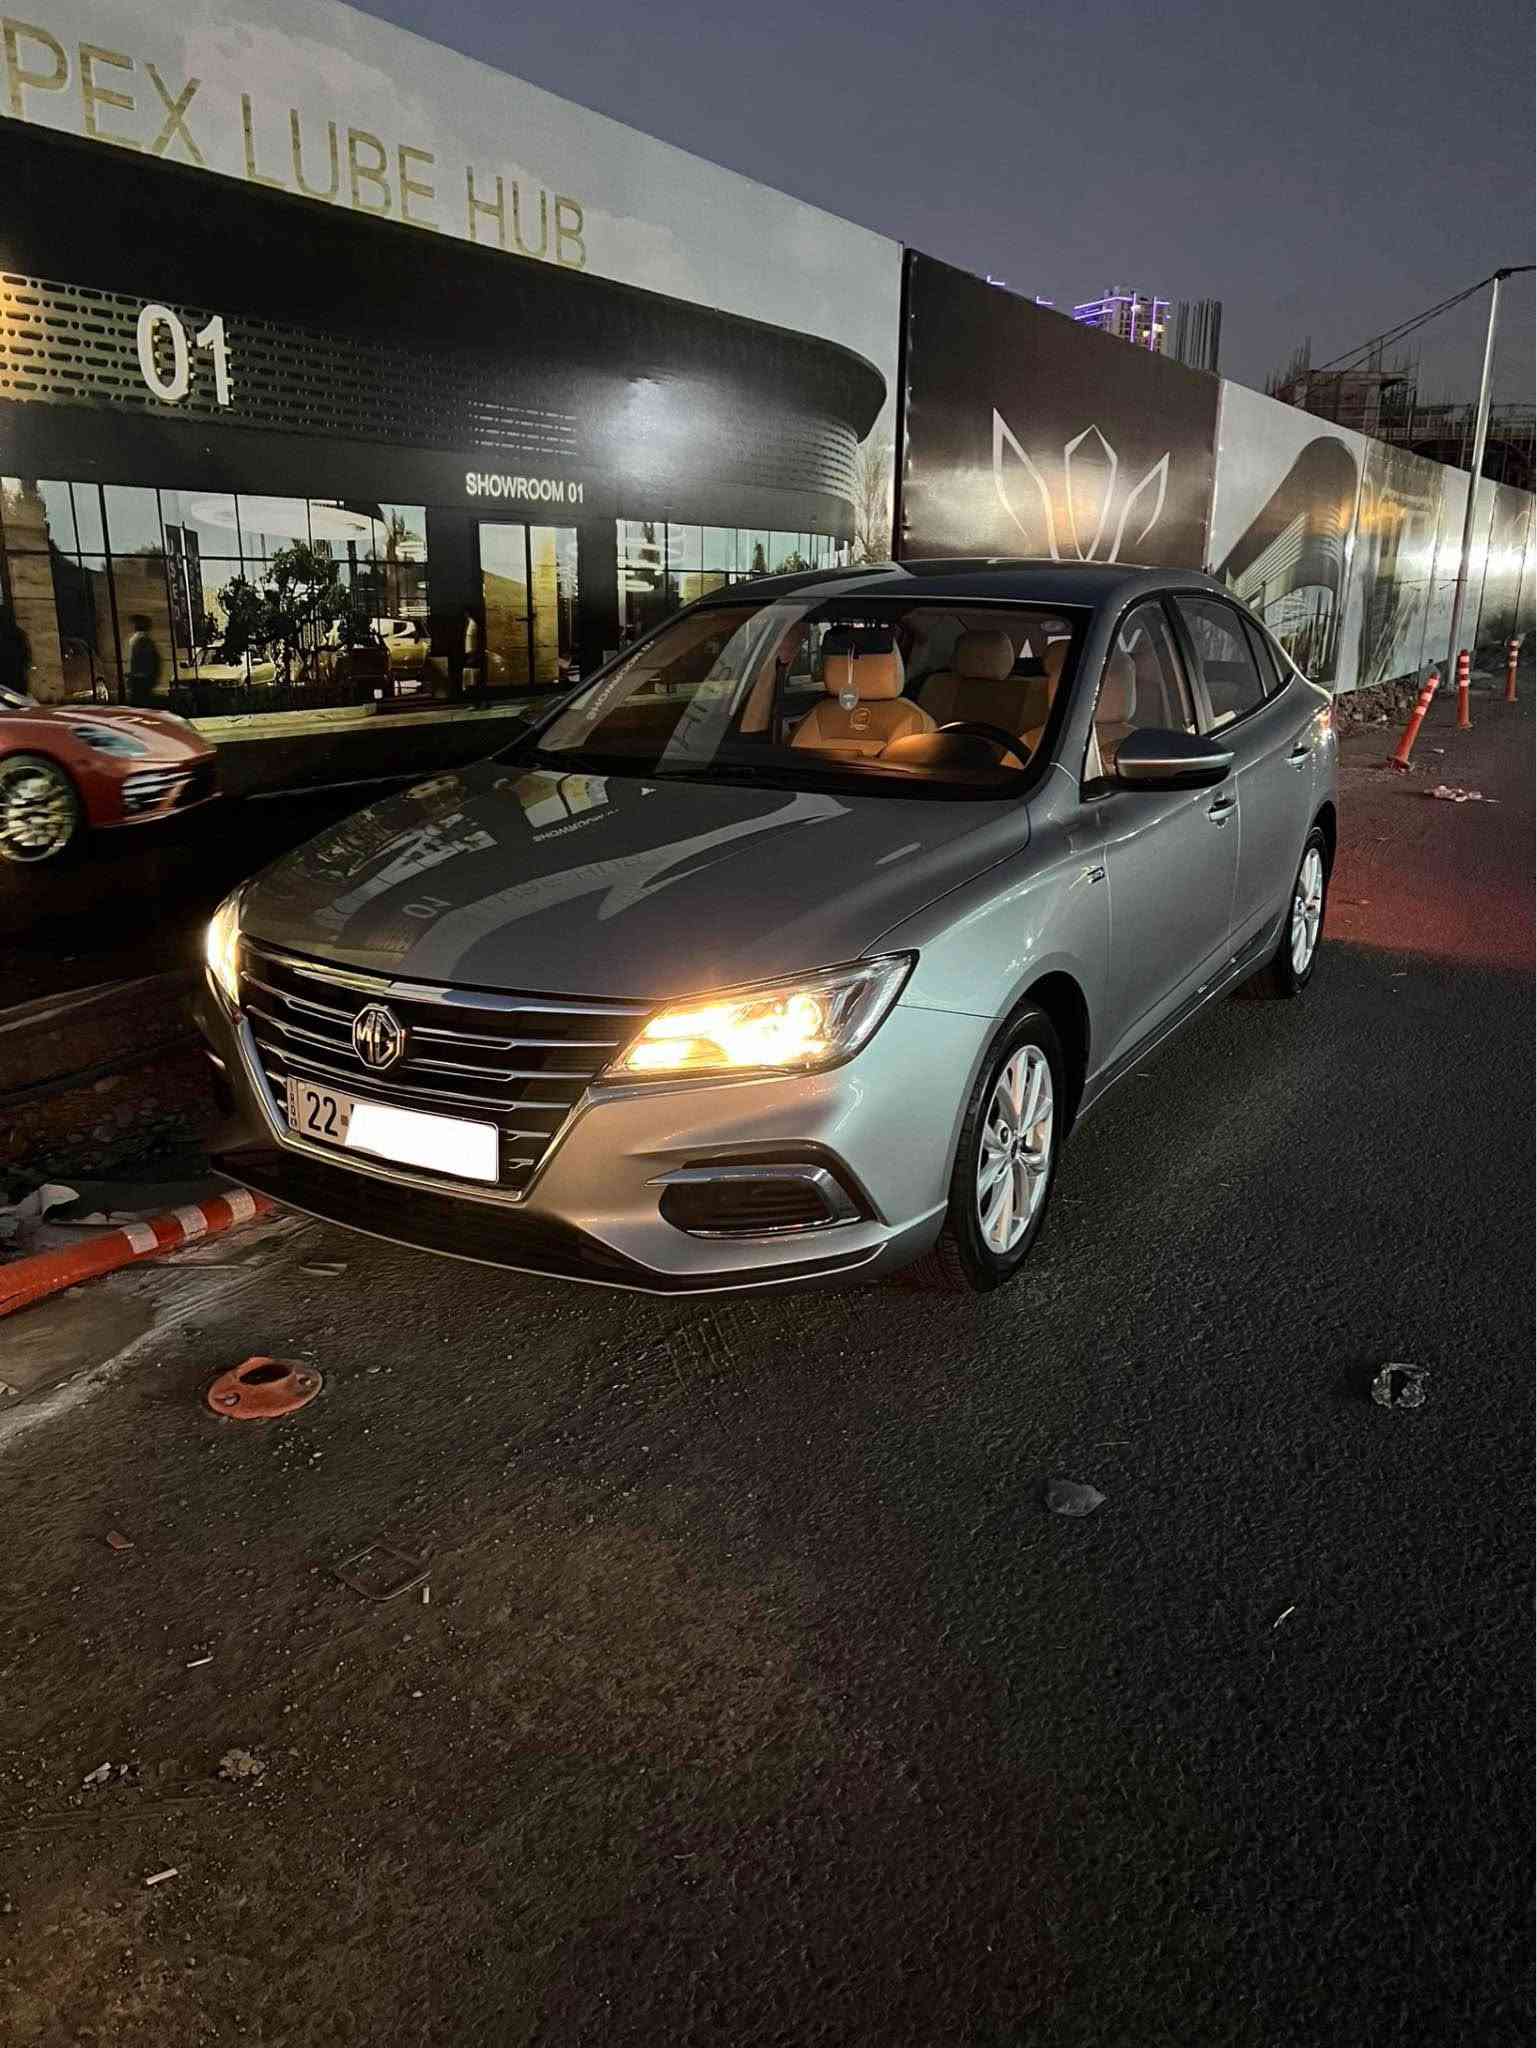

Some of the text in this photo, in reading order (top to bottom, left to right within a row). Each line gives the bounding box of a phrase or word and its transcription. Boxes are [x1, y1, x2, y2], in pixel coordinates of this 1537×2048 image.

[241, 93, 440, 230] LUBE
[467, 165, 586, 269] HUB
[137, 304, 230, 405] 01
[465, 472, 583, 503] SHOWROOM 01
[356, 1011, 396, 1064] MG
[307, 1091, 338, 1136] 22
